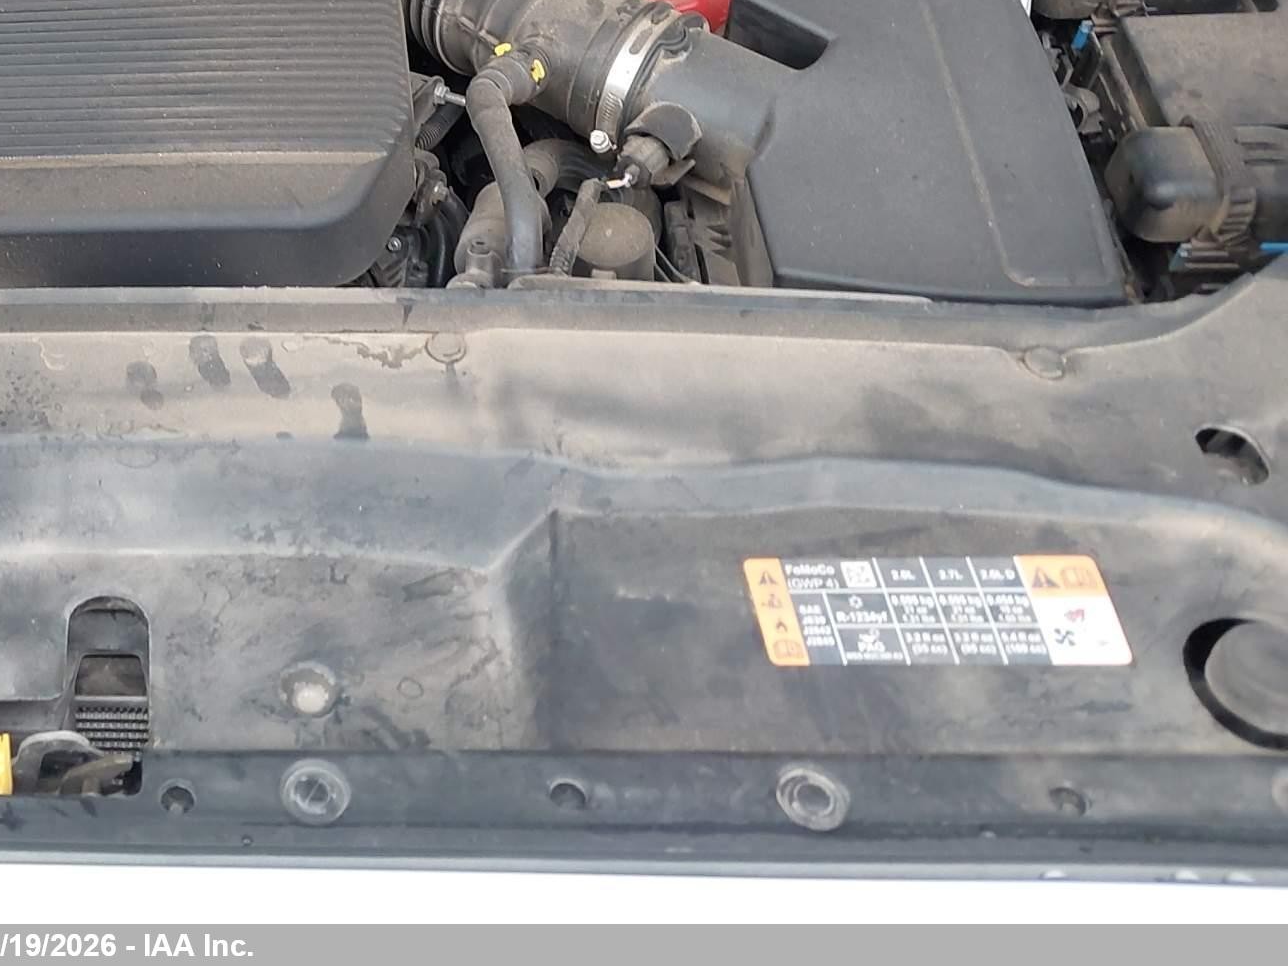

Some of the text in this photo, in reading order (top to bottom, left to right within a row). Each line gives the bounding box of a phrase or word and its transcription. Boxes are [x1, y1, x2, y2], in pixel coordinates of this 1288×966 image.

[785, 564, 835, 575] FoMoCo
[788, 578, 840, 589] (GWP 4)
[836, 611, 888, 624] R-1234yf
